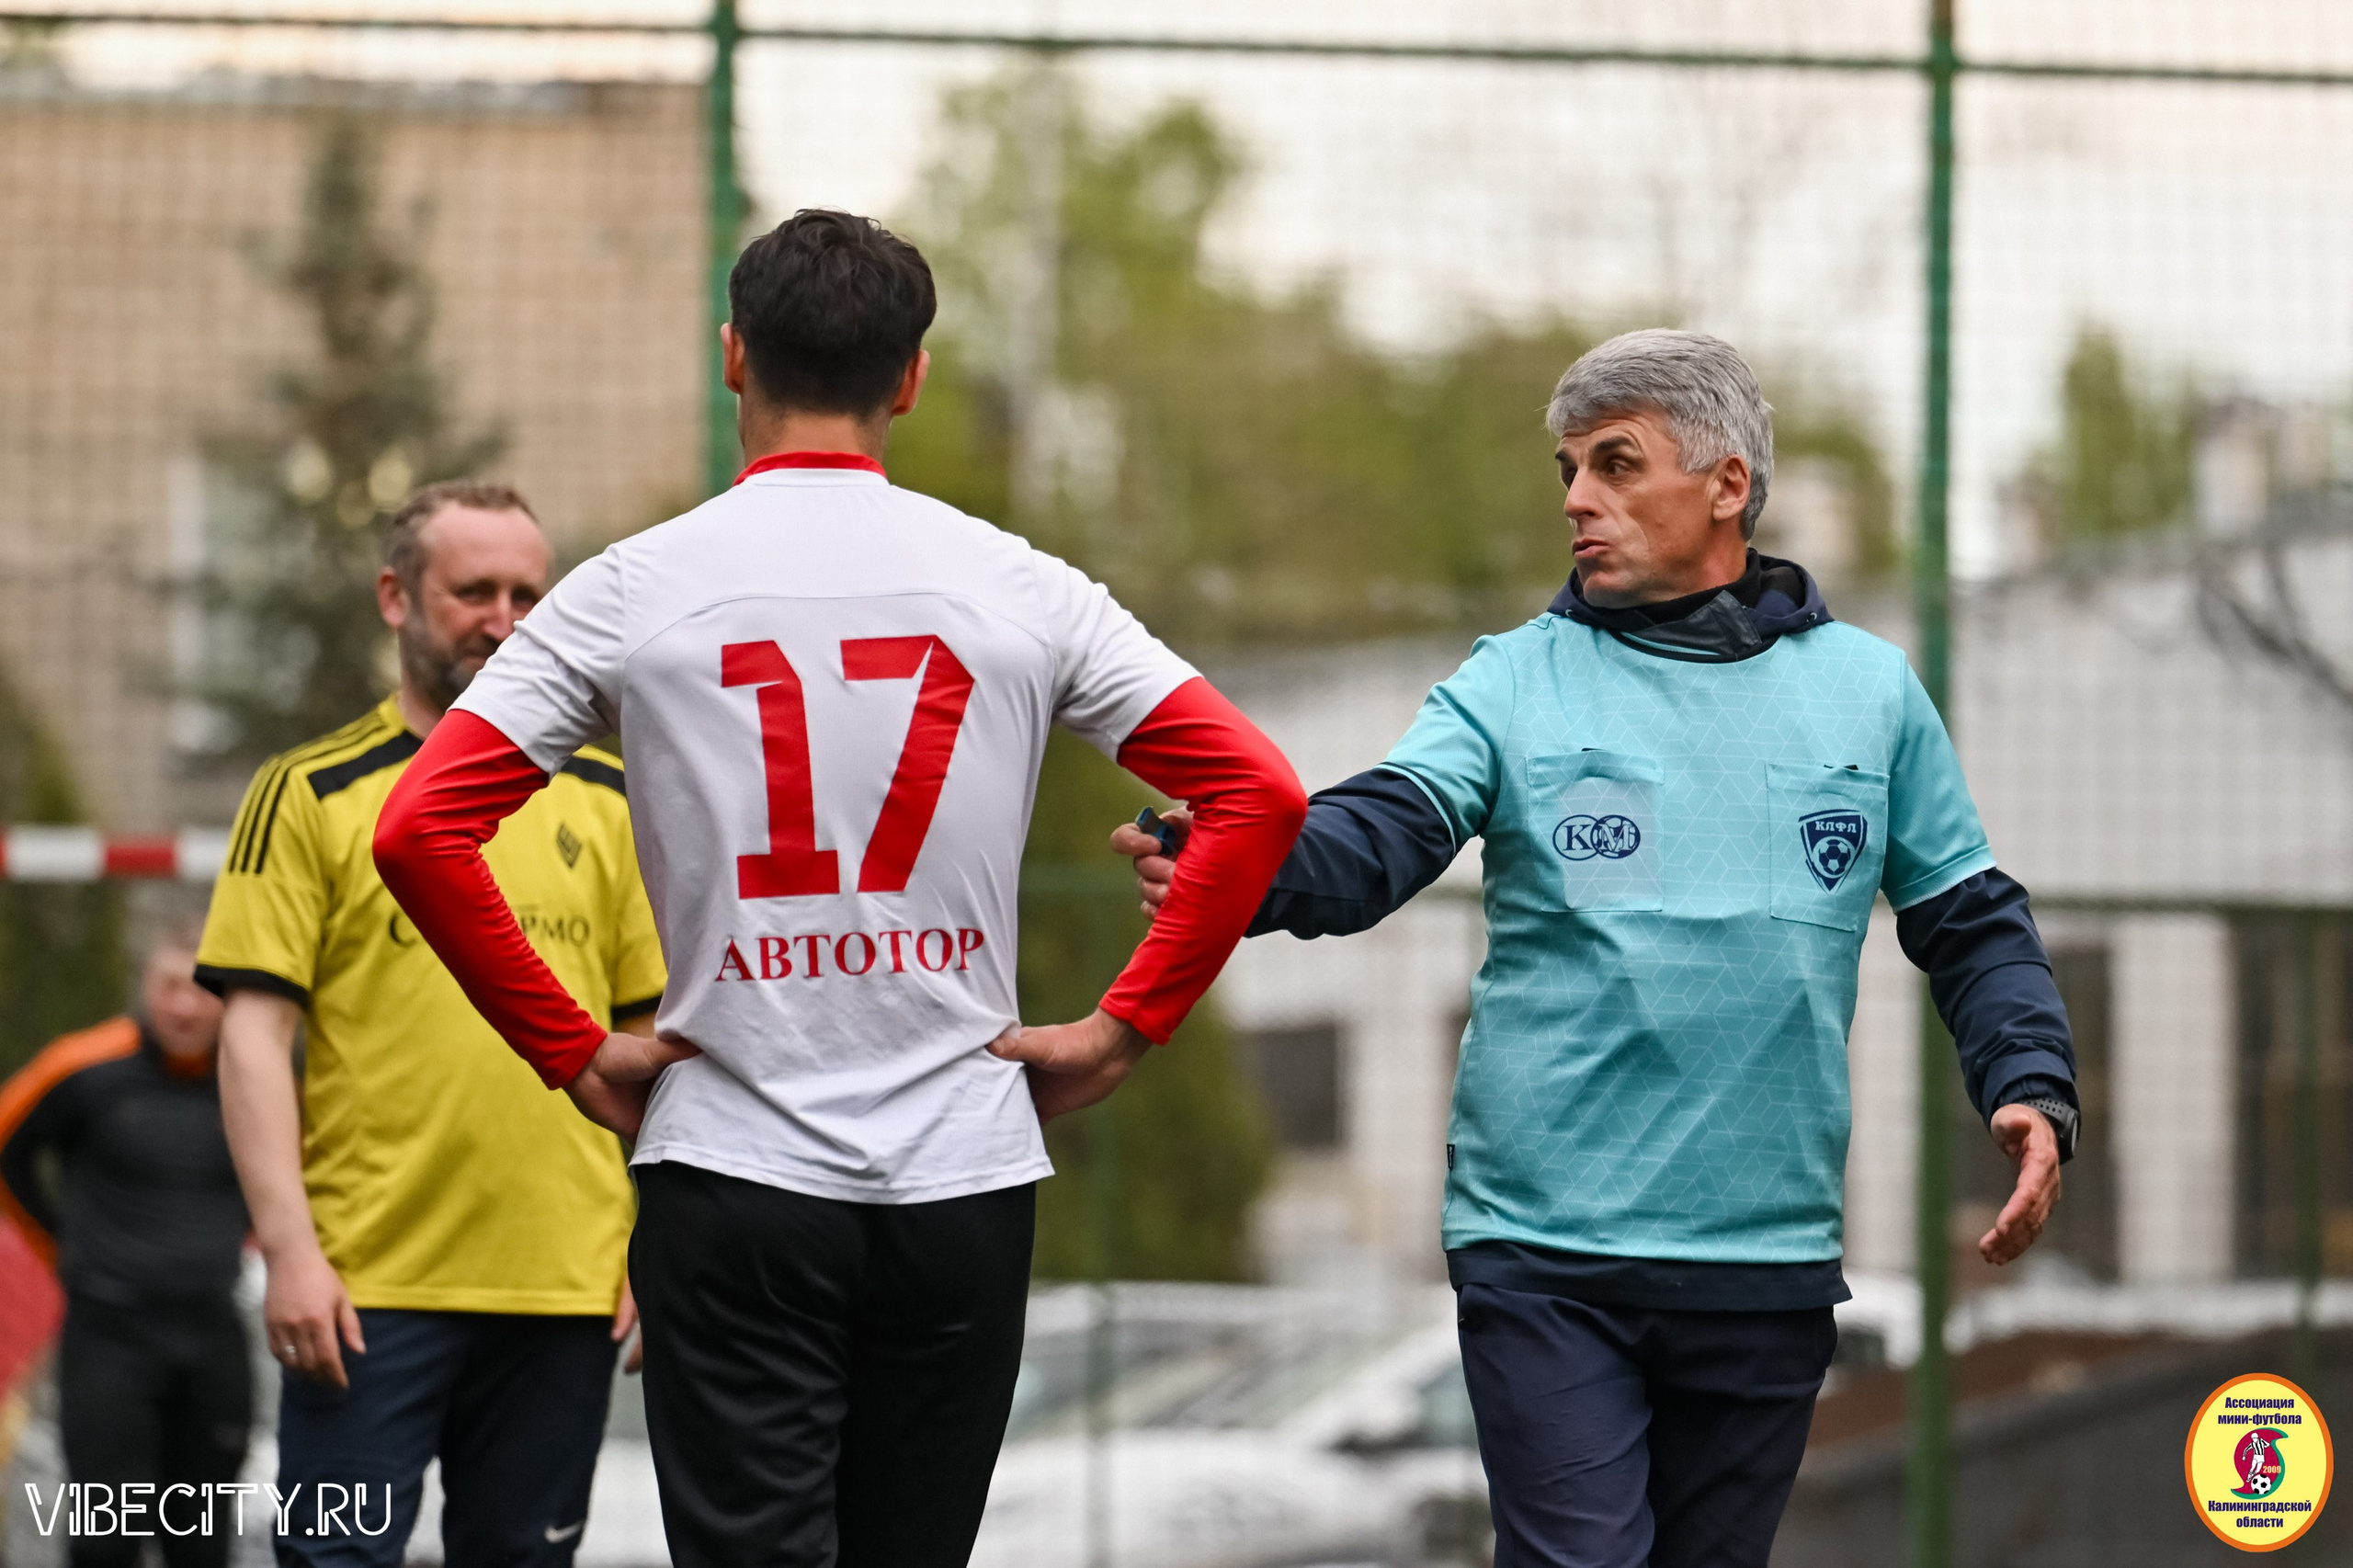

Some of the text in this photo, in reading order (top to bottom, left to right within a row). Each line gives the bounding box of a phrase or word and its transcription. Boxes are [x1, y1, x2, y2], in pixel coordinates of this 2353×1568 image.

[722, 634, 974, 900] 17
[1815, 821, 1857, 834] КЛФЛ
[714, 928, 984, 982] АВТОТОР
